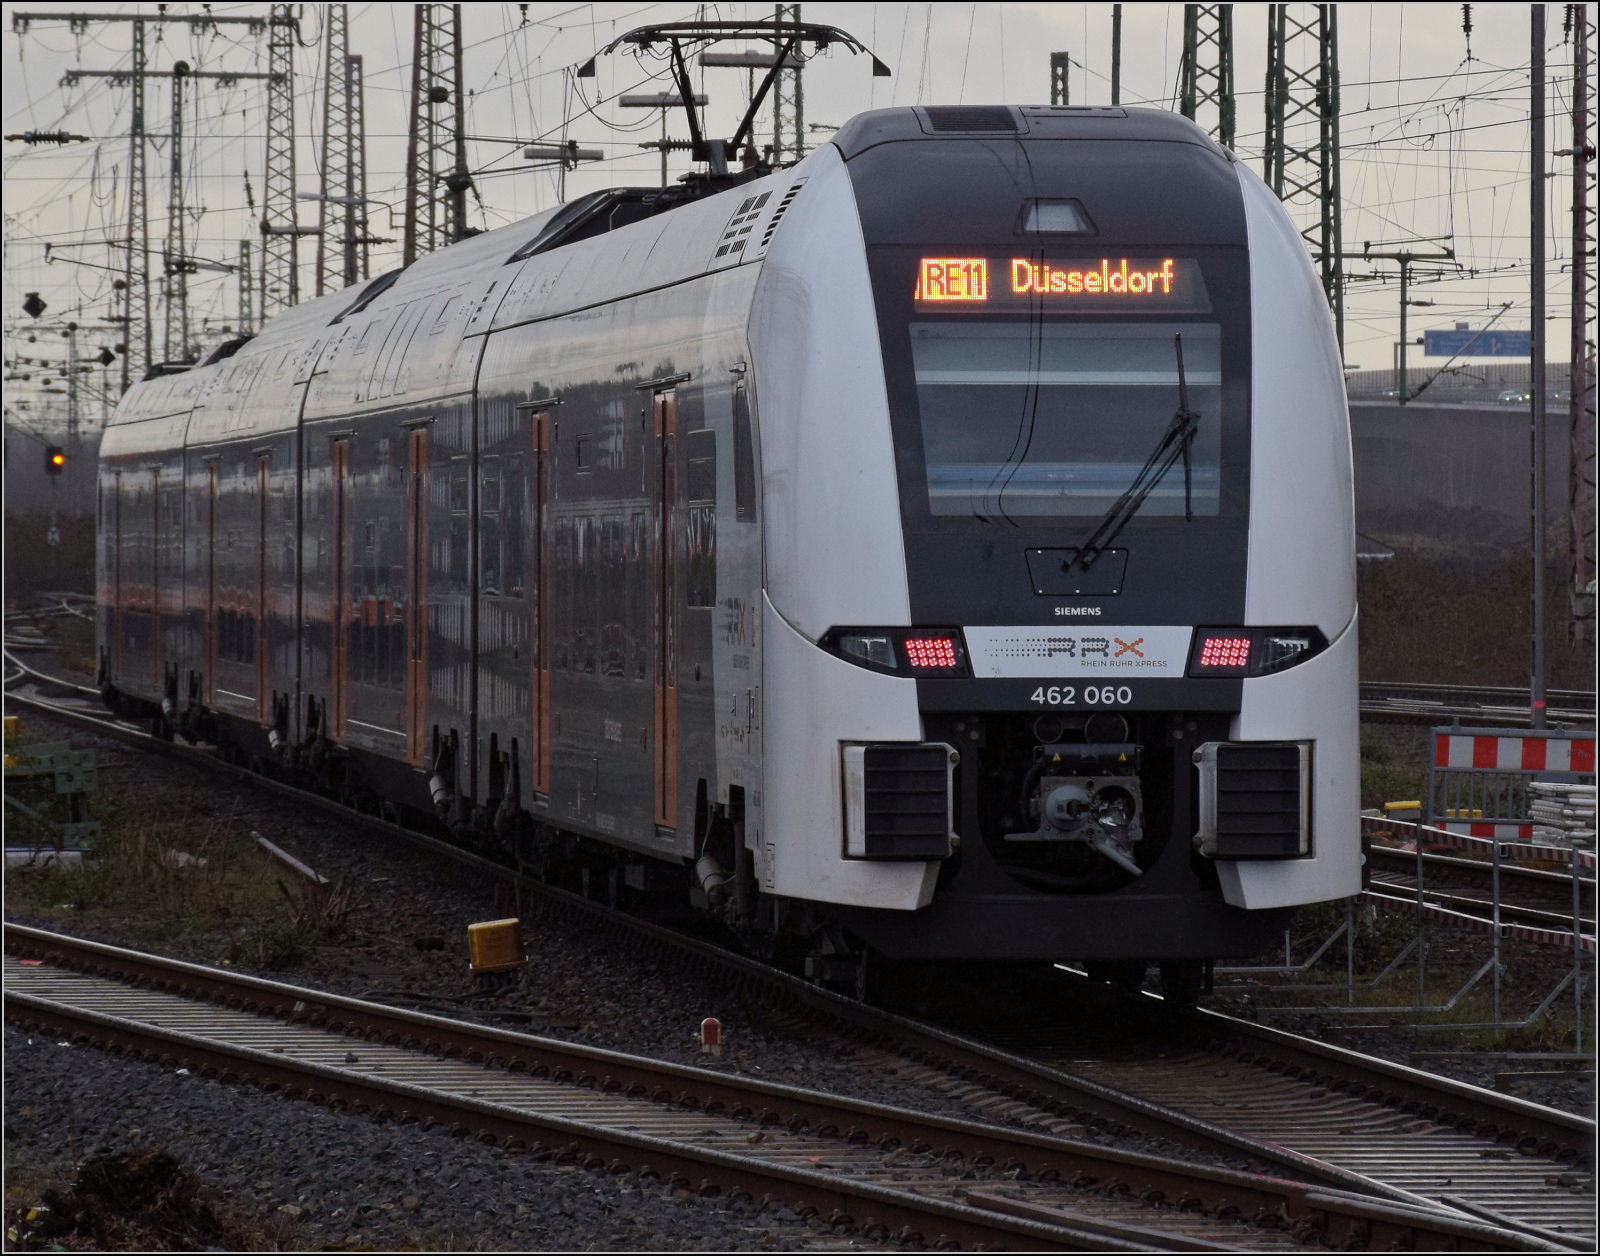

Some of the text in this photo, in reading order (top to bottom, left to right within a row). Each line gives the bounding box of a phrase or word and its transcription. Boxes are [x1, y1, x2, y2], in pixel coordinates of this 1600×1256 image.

[926, 258, 1174, 296] RE11 Düsseldorf
[1054, 607, 1101, 616] SIEMENS
[1047, 637, 1145, 658] RRX
[1080, 660, 1168, 668] RHEIN RUHR XPRESS
[1030, 686, 1132, 705] 462 060
